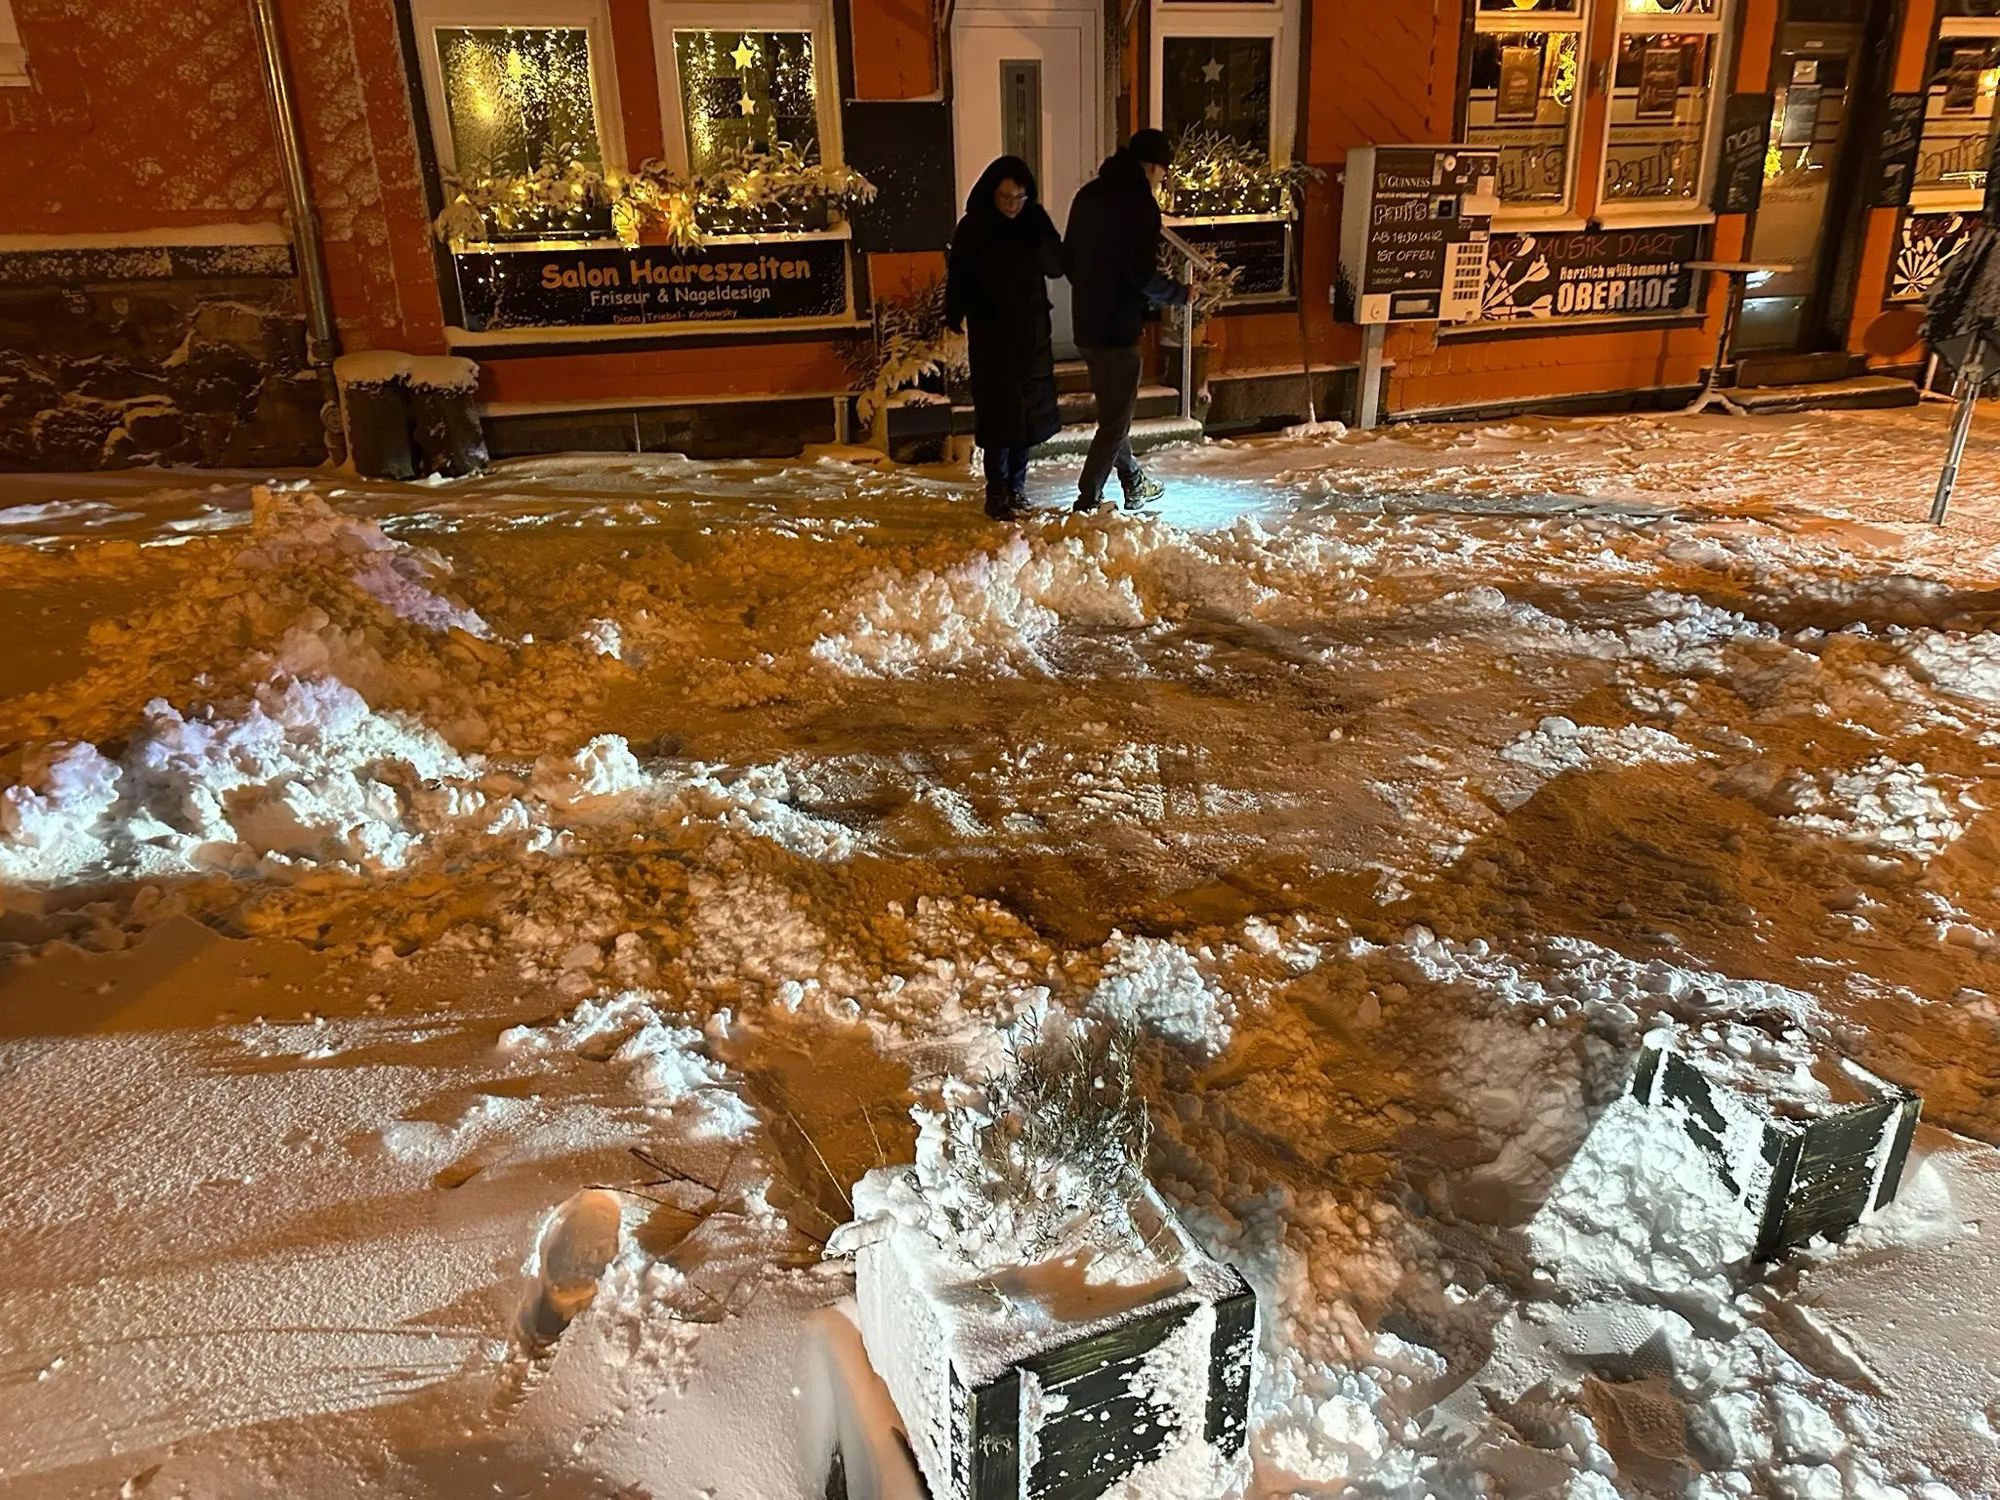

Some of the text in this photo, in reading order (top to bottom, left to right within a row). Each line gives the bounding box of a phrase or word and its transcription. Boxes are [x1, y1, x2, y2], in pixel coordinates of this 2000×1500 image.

[1387, 175, 1430, 188] GUINNESS
[1372, 231, 1390, 244] AB
[1393, 232, 1417, 245] 19:30
[1490, 238, 1523, 261] AR
[1617, 233, 1684, 258] DART
[541, 255, 811, 289] Salon Haareszeiten
[1560, 265, 1604, 281] Herzlich
[1606, 263, 1668, 279] willkommen
[590, 285, 771, 307] Friseur & Nageldesign
[1557, 277, 1678, 313] OBERHOF
[613, 313, 641, 324] Diana
